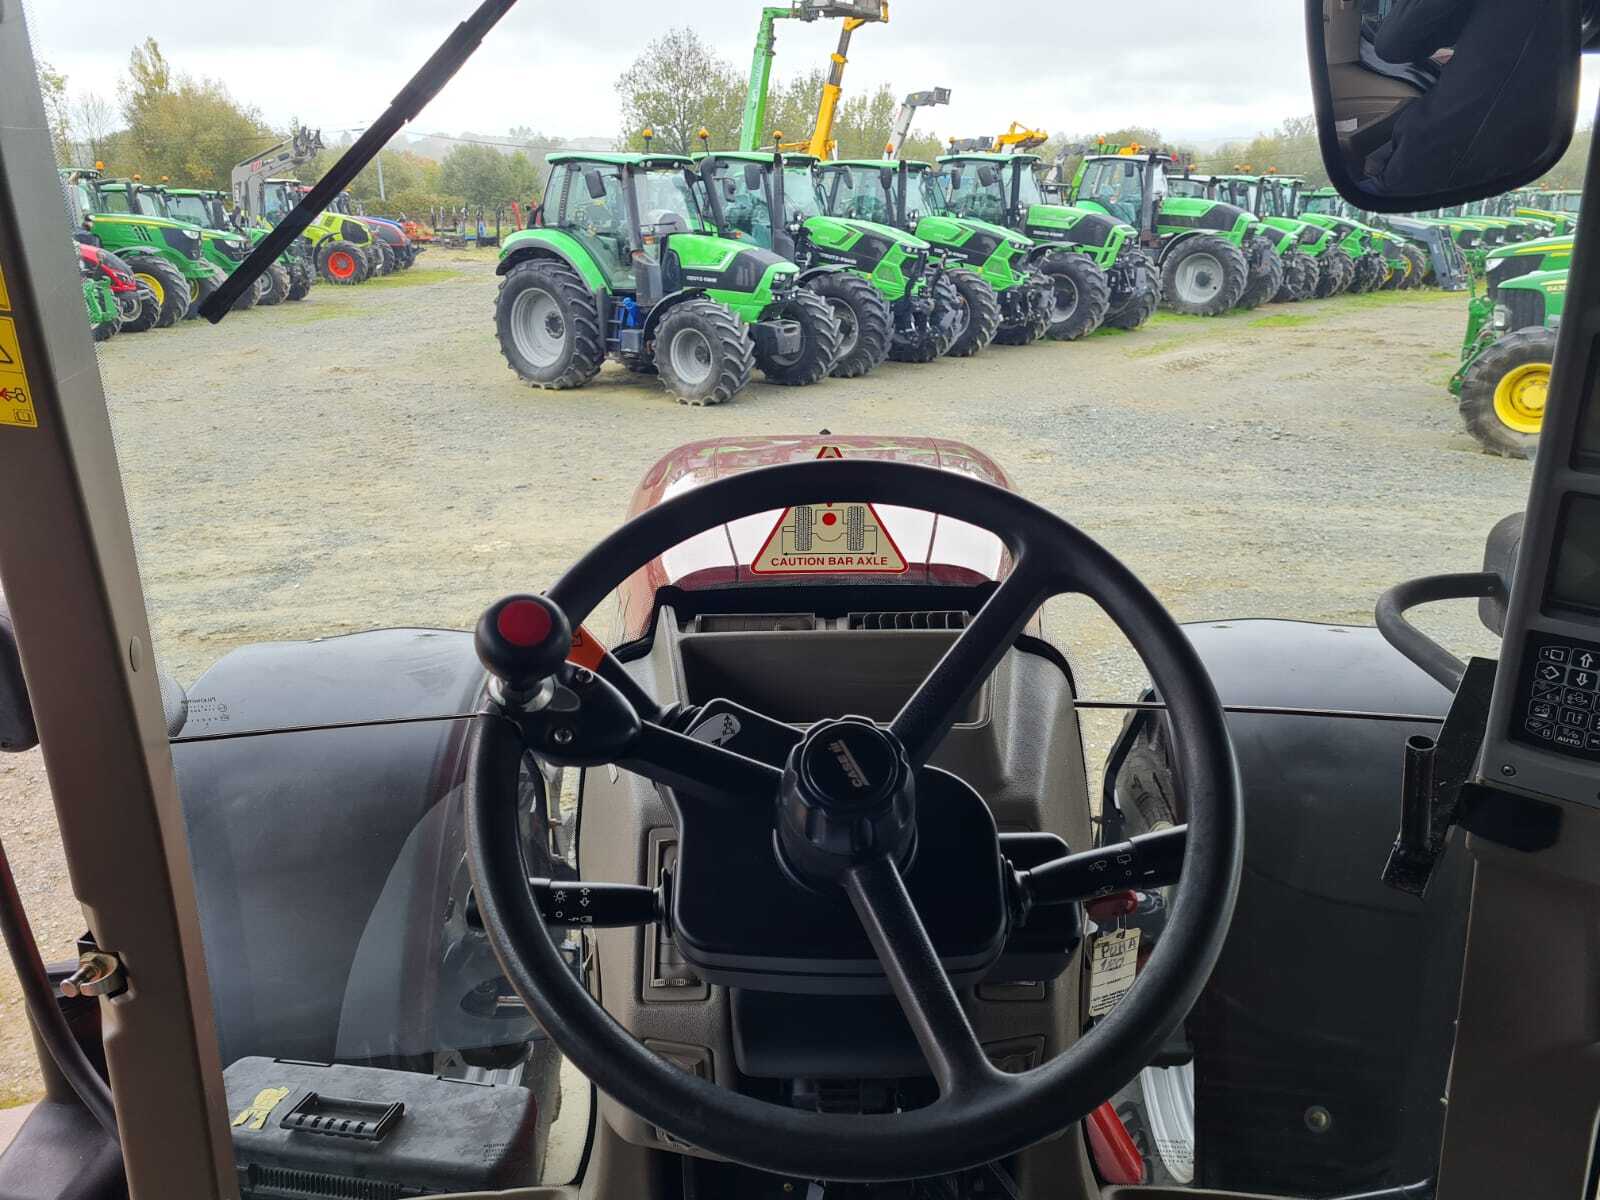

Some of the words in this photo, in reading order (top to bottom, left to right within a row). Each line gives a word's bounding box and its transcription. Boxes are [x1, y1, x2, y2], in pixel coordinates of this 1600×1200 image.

[771, 557, 825, 566] CAUTION
[828, 557, 854, 566] BAR
[857, 556, 889, 566] AXLE
[1557, 735, 1581, 746] AUTO
